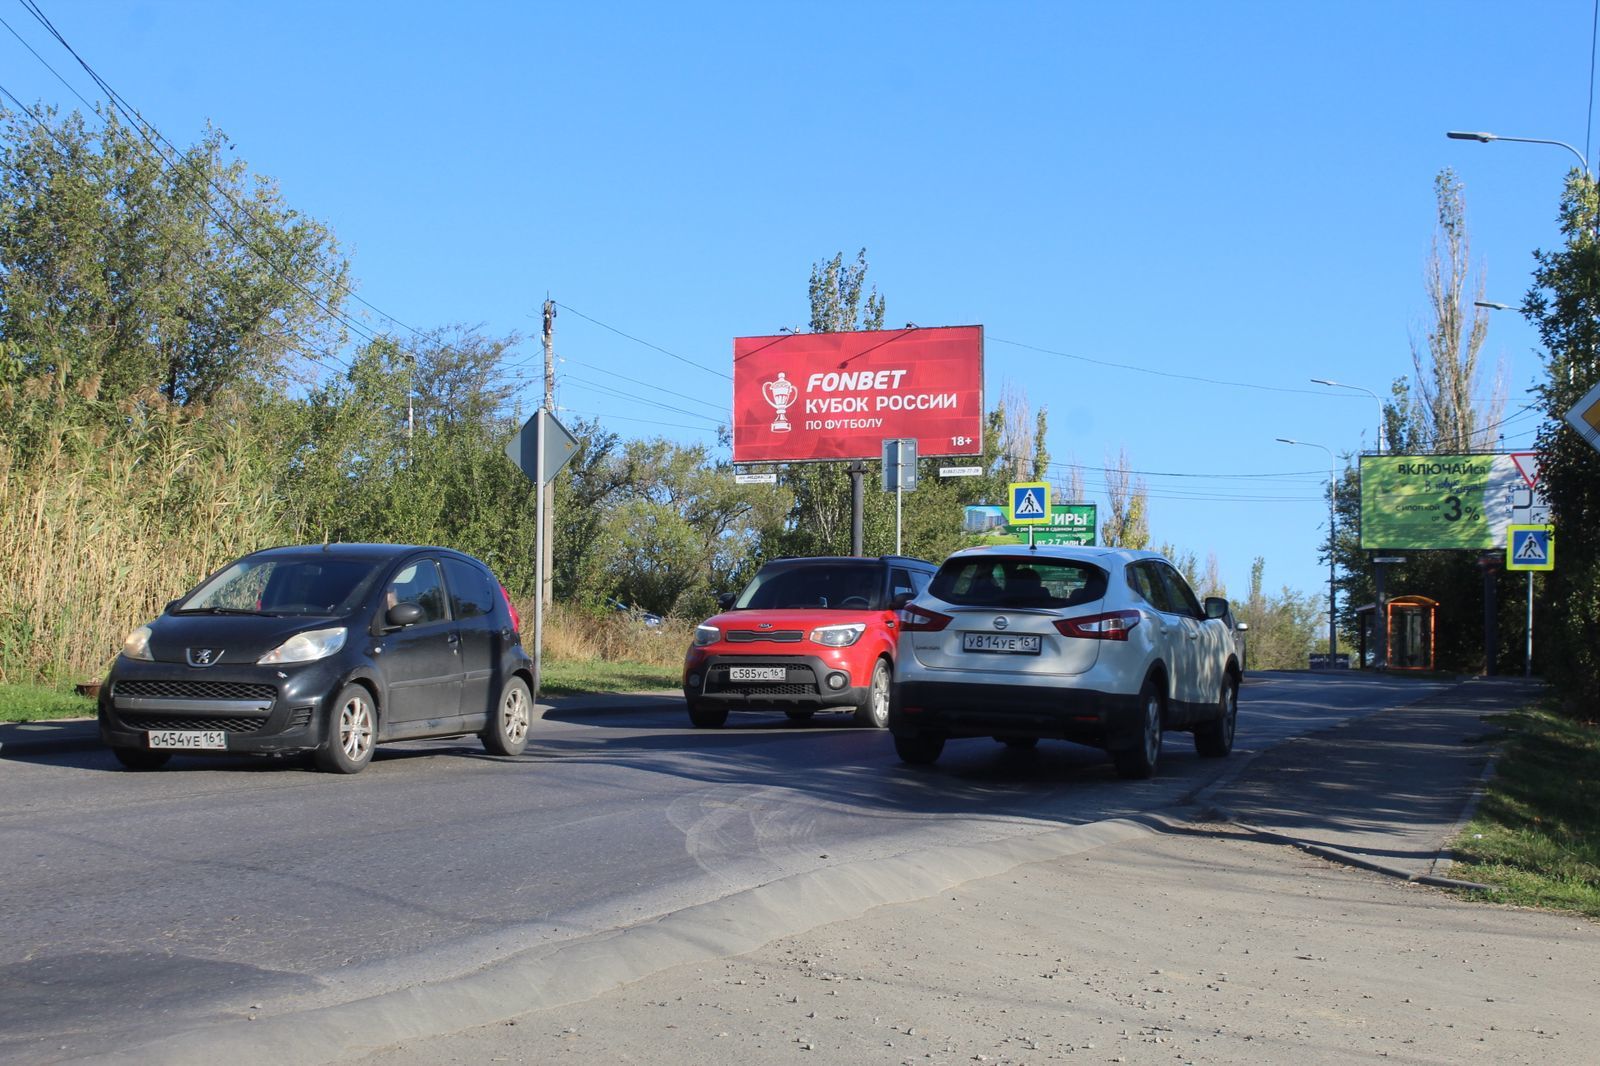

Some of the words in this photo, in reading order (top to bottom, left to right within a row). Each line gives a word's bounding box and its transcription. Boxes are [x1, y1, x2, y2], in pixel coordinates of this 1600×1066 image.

[806, 370, 907, 392] FONBET
[805, 396, 869, 414] КУБОК
[876, 393, 957, 411] РОССИИ
[805, 420, 822, 430] ПО
[825, 418, 883, 430] ФУТБОЛУ
[951, 436, 972, 446] 18+
[1444, 496, 1462, 521] 3
[1050, 513, 1087, 525] ТИРЫ
[1019, 637, 1037, 647] 161
[202, 732, 223, 744] 161
